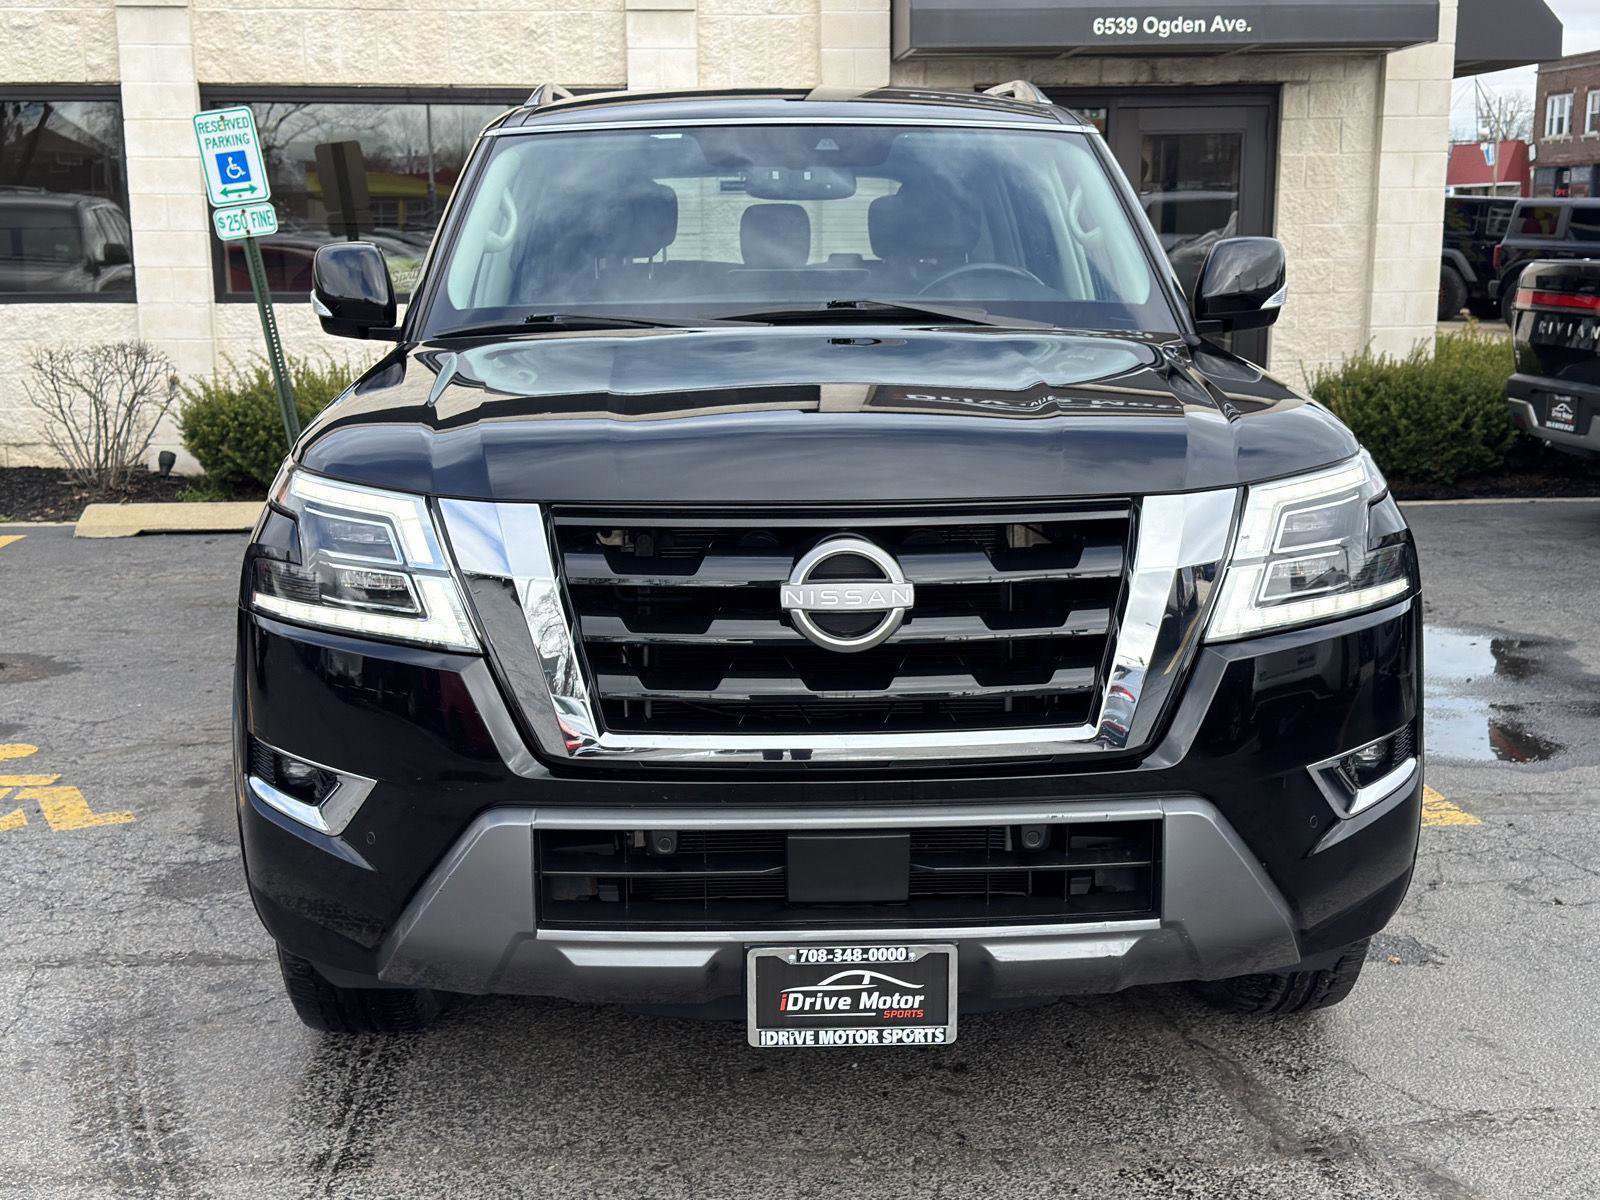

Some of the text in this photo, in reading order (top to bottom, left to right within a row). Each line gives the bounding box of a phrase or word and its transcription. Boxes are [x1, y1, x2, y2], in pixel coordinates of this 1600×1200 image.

[1093, 15, 1252, 38] 6539 Ogden Ave.
[198, 116, 249, 134] RESERVED
[205, 133, 250, 150] PARKING
[250, 209, 275, 228] FINE
[785, 589, 909, 605] NISSAN
[799, 948, 906, 962] 708-348-0000
[780, 991, 924, 1011] iDrive Motor
[883, 1009, 924, 1019] SPORTS
[818, 1030, 879, 1044] MOTOR
[882, 1028, 944, 1043] SPORTS
